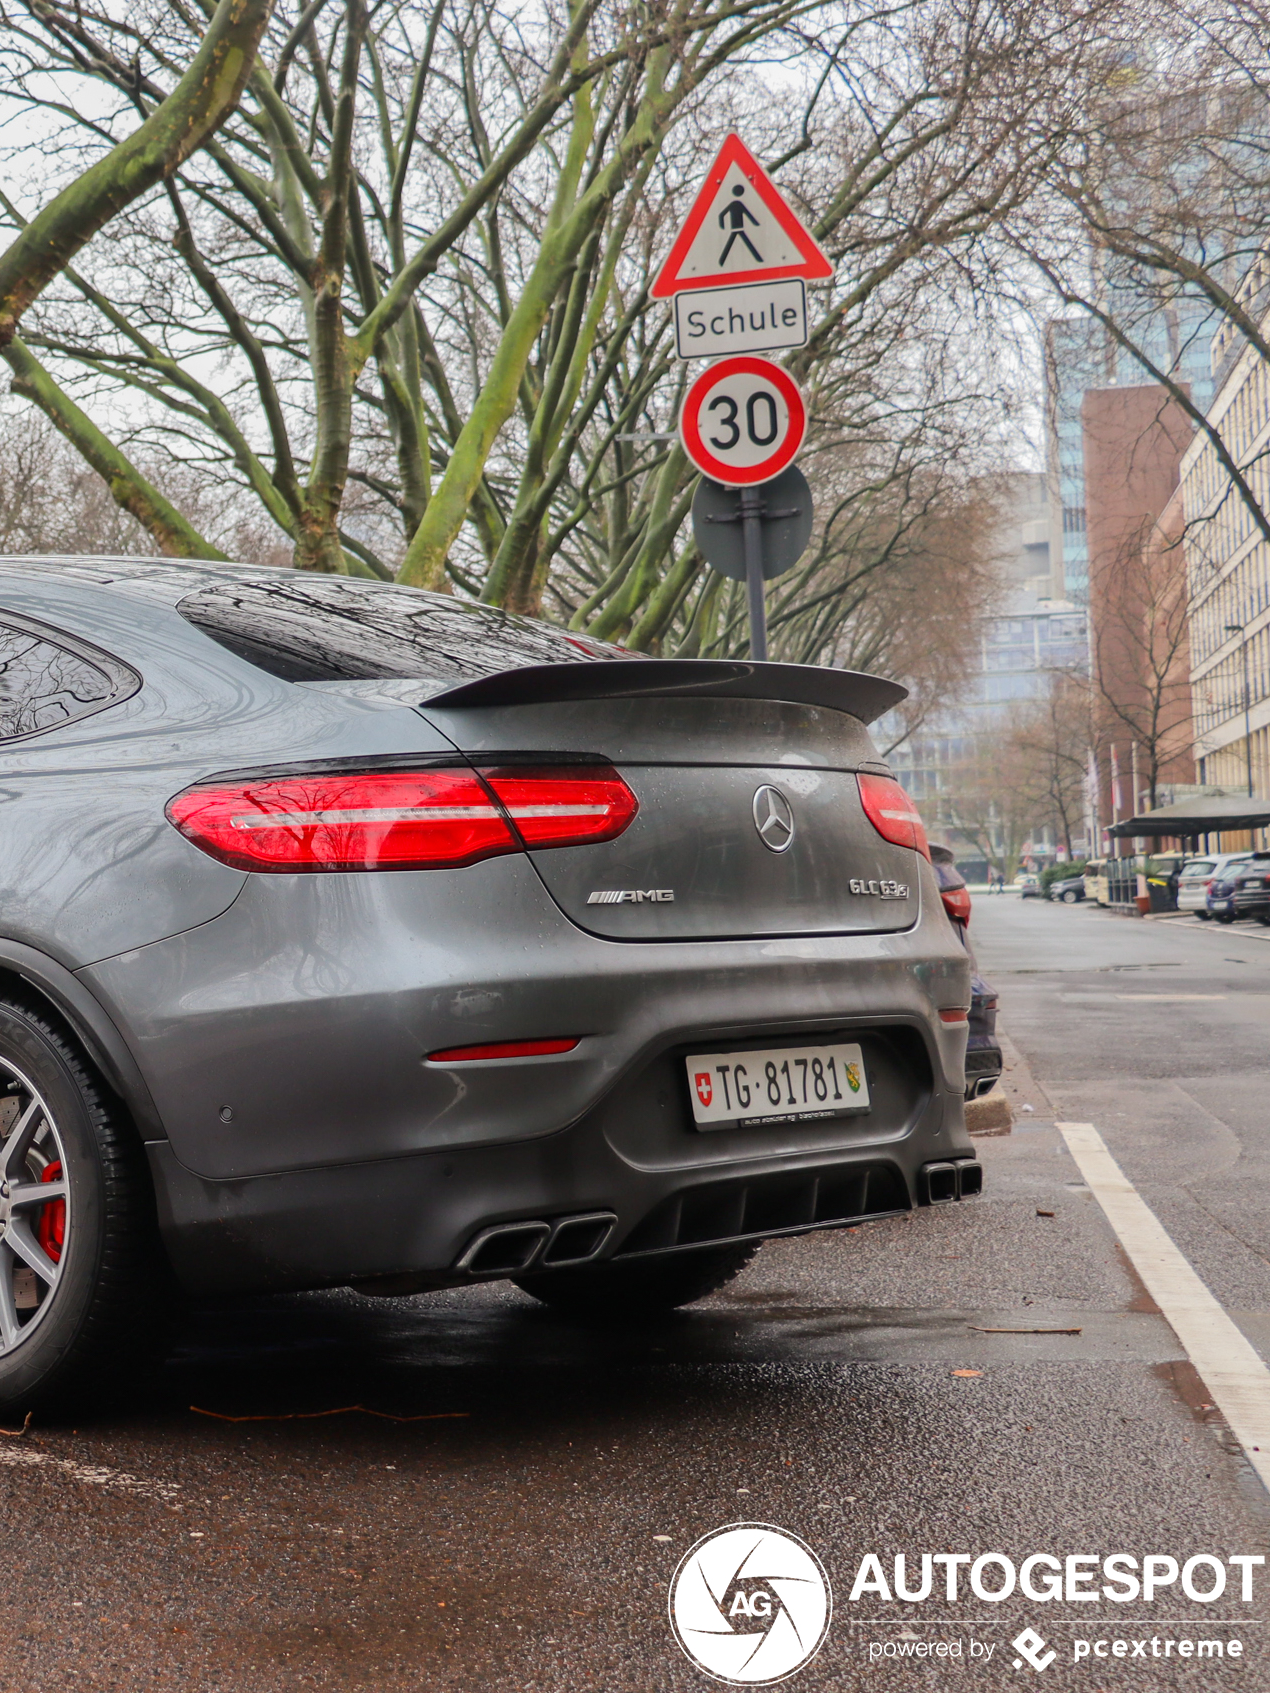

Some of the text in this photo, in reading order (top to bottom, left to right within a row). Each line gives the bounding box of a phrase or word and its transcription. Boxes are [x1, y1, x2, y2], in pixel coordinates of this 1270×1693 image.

[687, 302, 798, 338] Schule
[708, 391, 778, 450] 30
[849, 879, 879, 894] GLC
